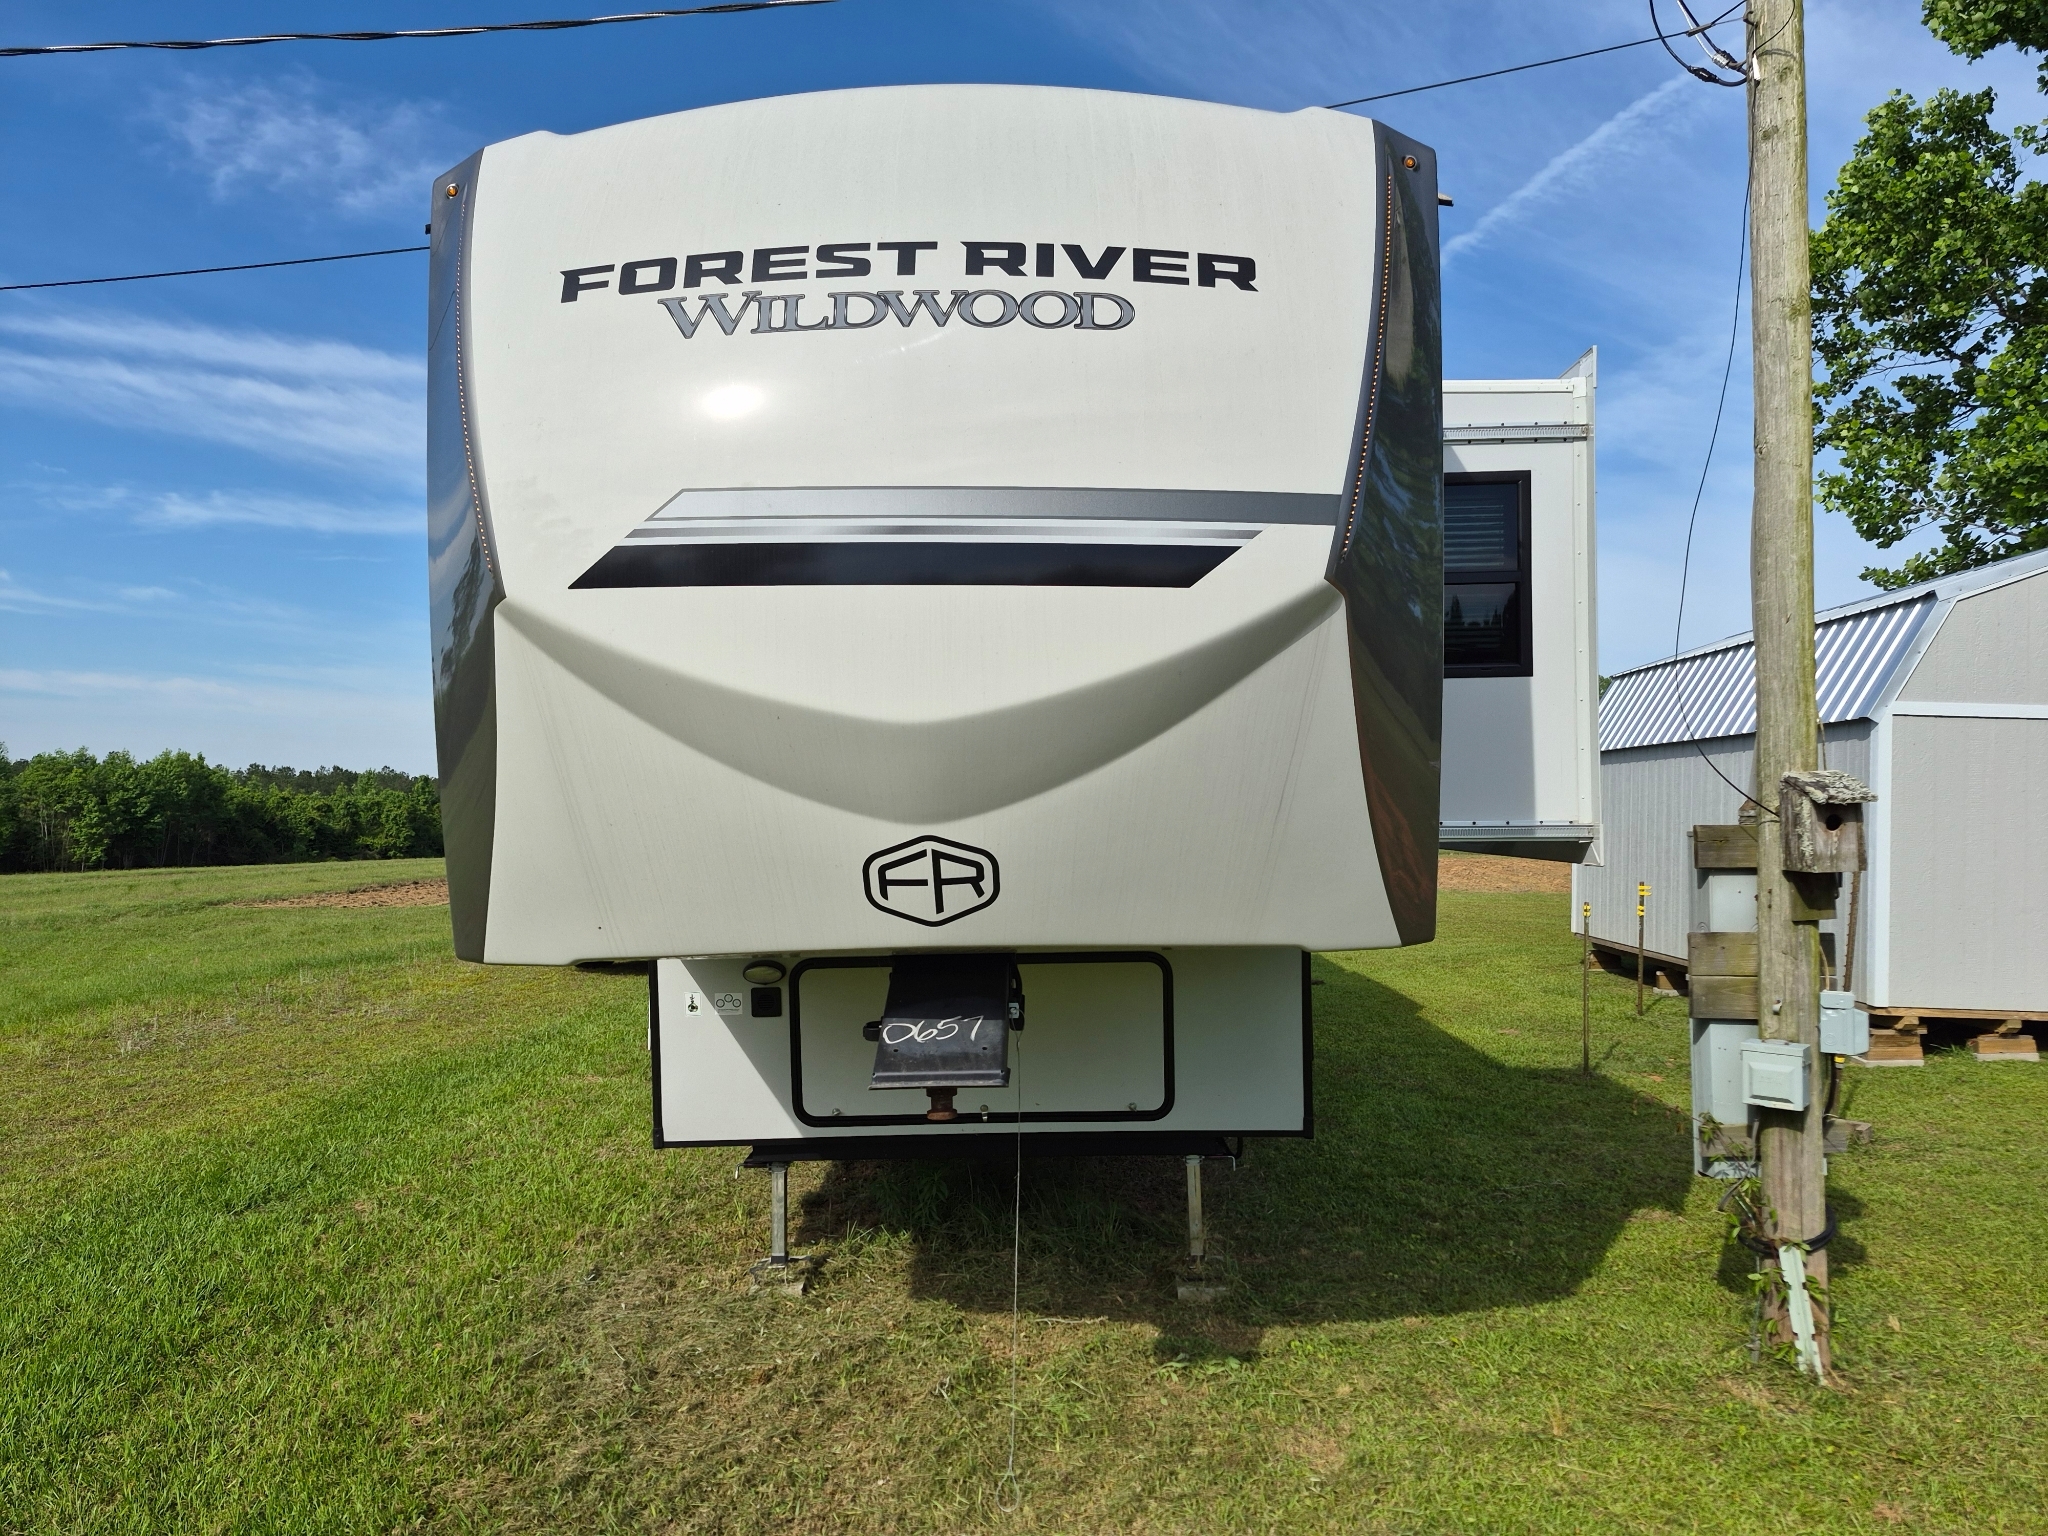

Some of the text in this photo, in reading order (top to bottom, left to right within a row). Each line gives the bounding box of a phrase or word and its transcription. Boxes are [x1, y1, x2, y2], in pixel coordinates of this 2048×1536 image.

[560, 241, 1259, 304] FOREST RIVER
[657, 289, 1136, 340] WILDWOOD
[877, 848, 986, 915] FR
